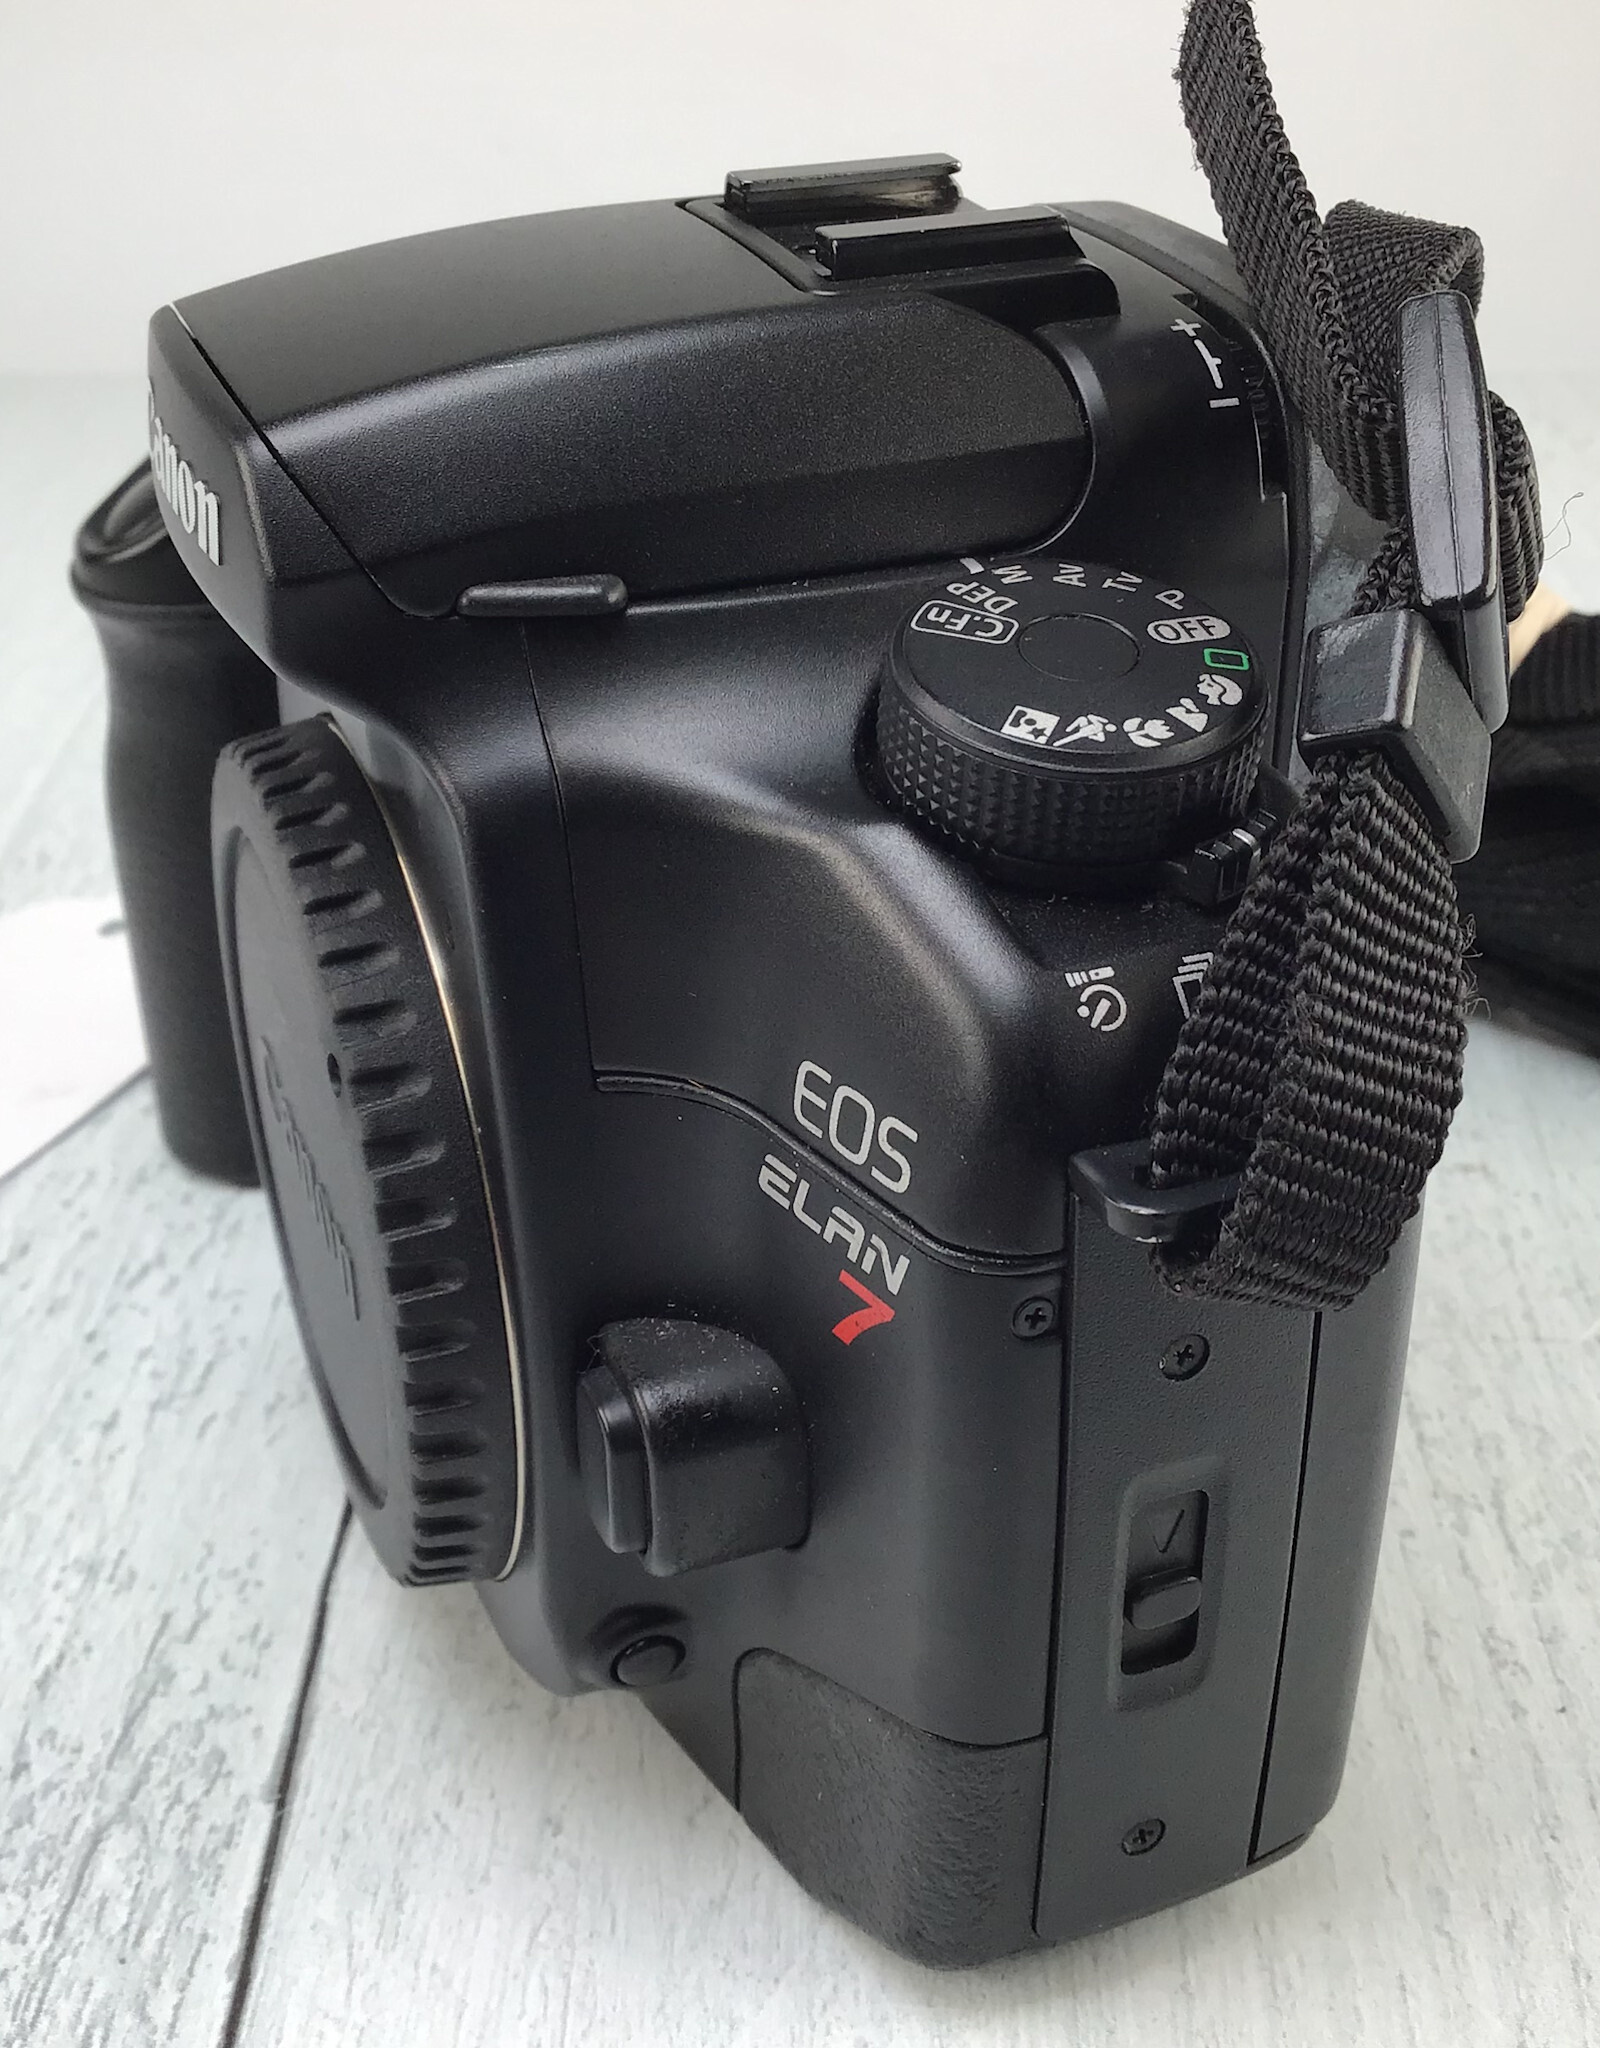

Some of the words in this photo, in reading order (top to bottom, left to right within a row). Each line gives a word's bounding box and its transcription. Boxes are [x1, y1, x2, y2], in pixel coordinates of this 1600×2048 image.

[149, 376, 220, 567] anon
[991, 564, 1034, 585] M
[946, 581, 1019, 614] DEP
[1155, 589, 1185, 610] P
[926, 606, 1004, 637] C.Fn
[1153, 617, 1216, 641] OFF
[793, 1059, 919, 1194] EOS
[758, 1153, 911, 1297] ELAN
[831, 1269, 896, 1347] 7
